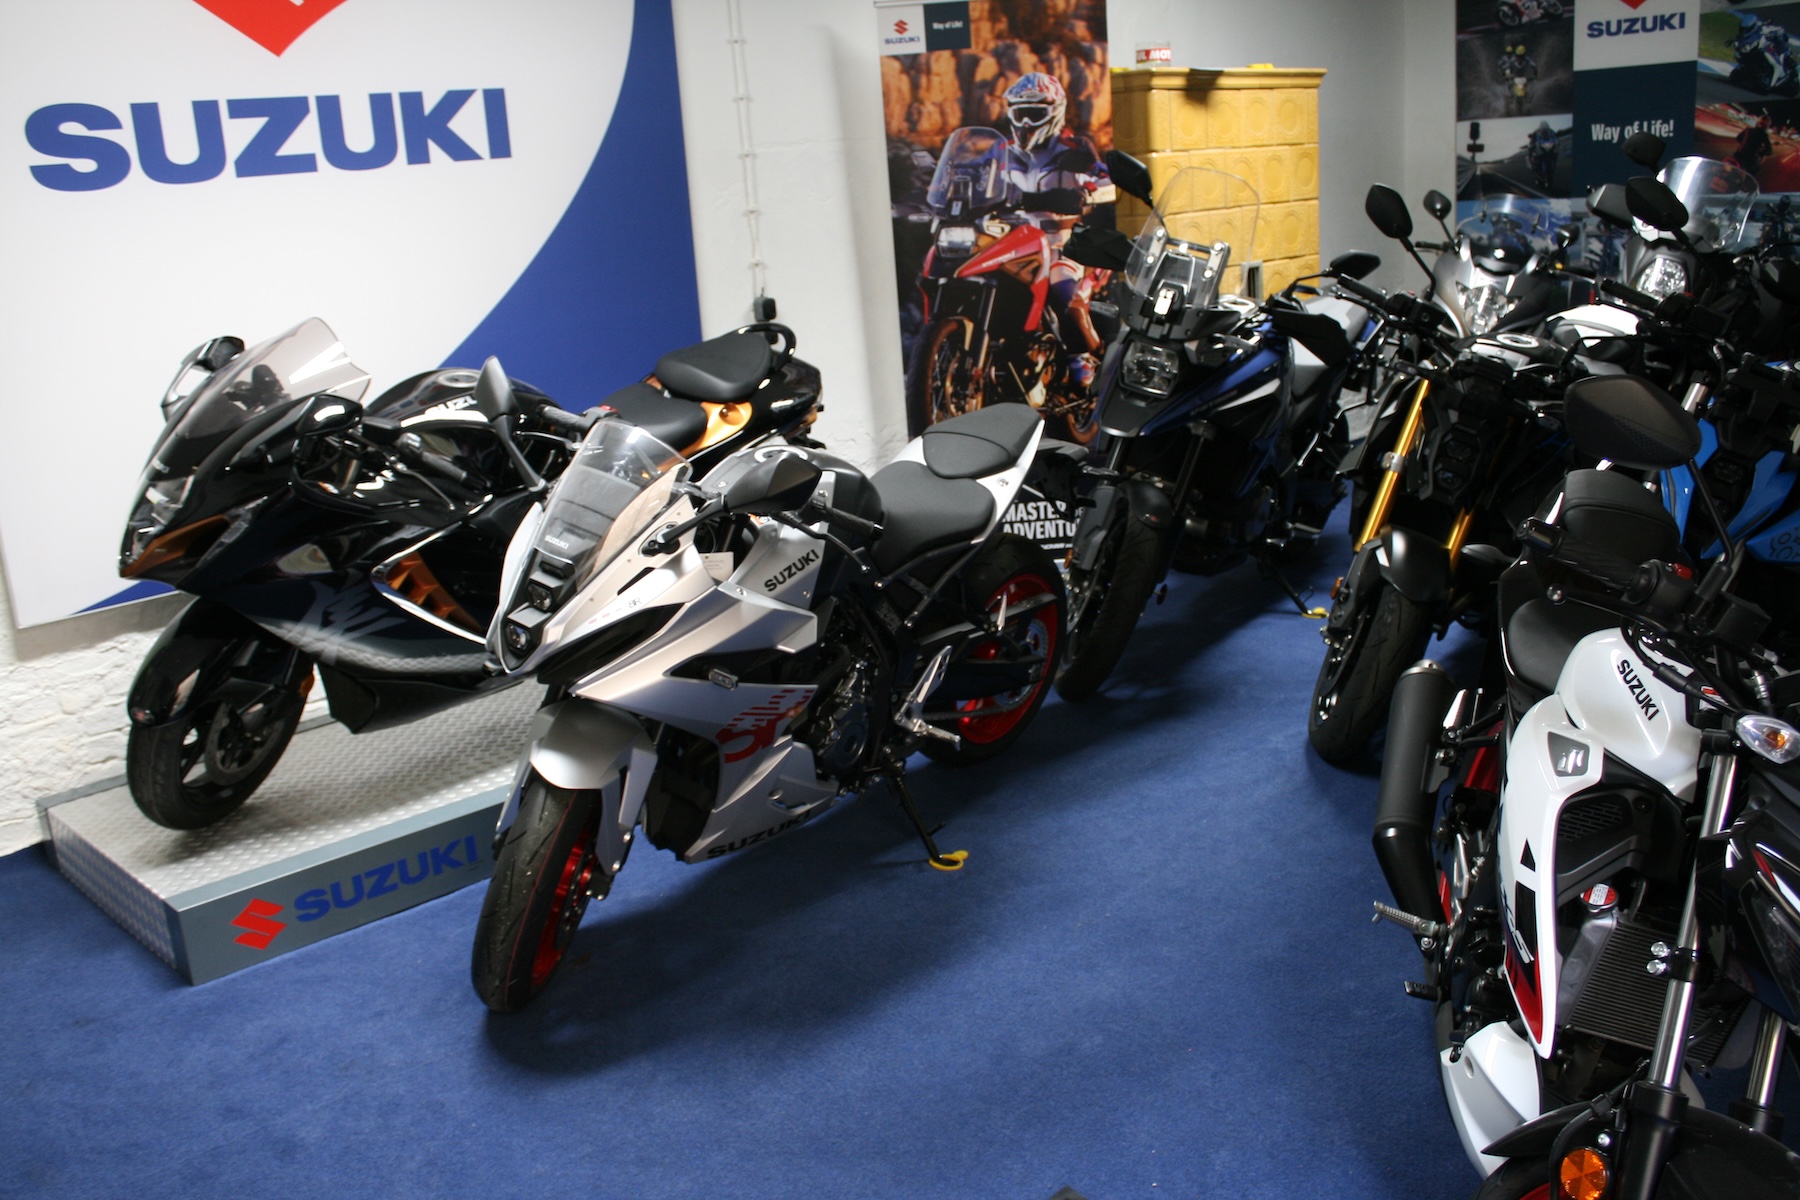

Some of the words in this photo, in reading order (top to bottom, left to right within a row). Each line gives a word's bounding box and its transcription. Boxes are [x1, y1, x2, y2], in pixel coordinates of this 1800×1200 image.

[884, 36, 920, 44] SUZUKI
[932, 22, 944, 30] Way
[952, 20, 963, 28] Life!
[1586, 12, 1686, 38] SUZUKI
[24, 88, 512, 192] SUZUKI
[1591, 123, 1620, 143] Way
[1624, 121, 1639, 139] of
[1642, 120, 1674, 137] Life!
[763, 549, 820, 592] SUZUKI
[1617, 659, 1660, 721] SUZUKI
[707, 808, 811, 858] SUZUKI
[294, 835, 478, 922] SUZUKI
